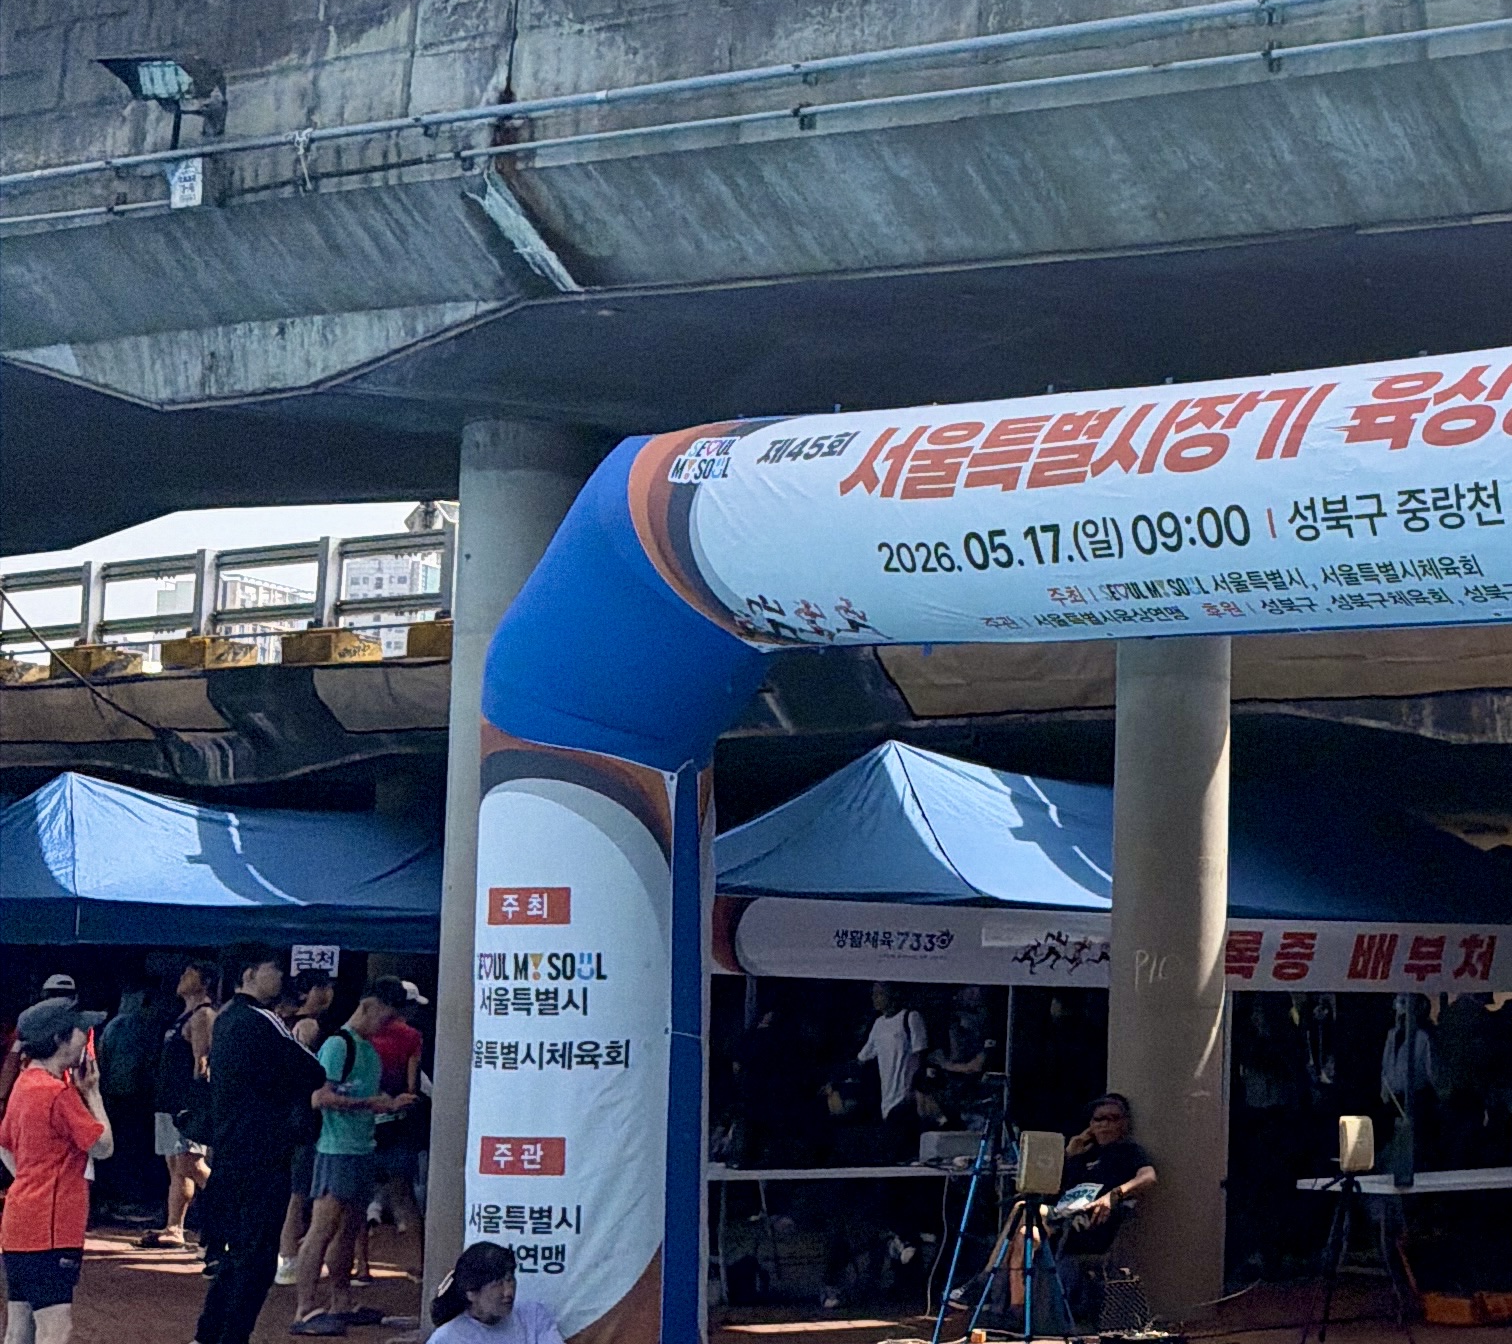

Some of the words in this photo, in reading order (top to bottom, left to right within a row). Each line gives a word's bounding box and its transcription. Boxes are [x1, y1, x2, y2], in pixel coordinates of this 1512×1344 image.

[757, 431, 861, 465] 제45회
[839, 383, 1338, 500] 서울특별시장기
[1131, 504, 1251, 556] 09:00
[1288, 492, 1387, 542] 성북구
[1397, 479, 1505, 533] 중랑천
[1047, 585, 1089, 606] 주최
[1321, 554, 1484, 587] 서울특별시체육회
[1201, 600, 1247, 619] 후원
[1225, 931, 1317, 981] 록증
[1347, 933, 1497, 982] 배부처
[480, 986, 588, 1016] 서울특별시
[473, 1039, 631, 1070] 울특별시체육회
[469, 1203, 582, 1235] 서울특별시
